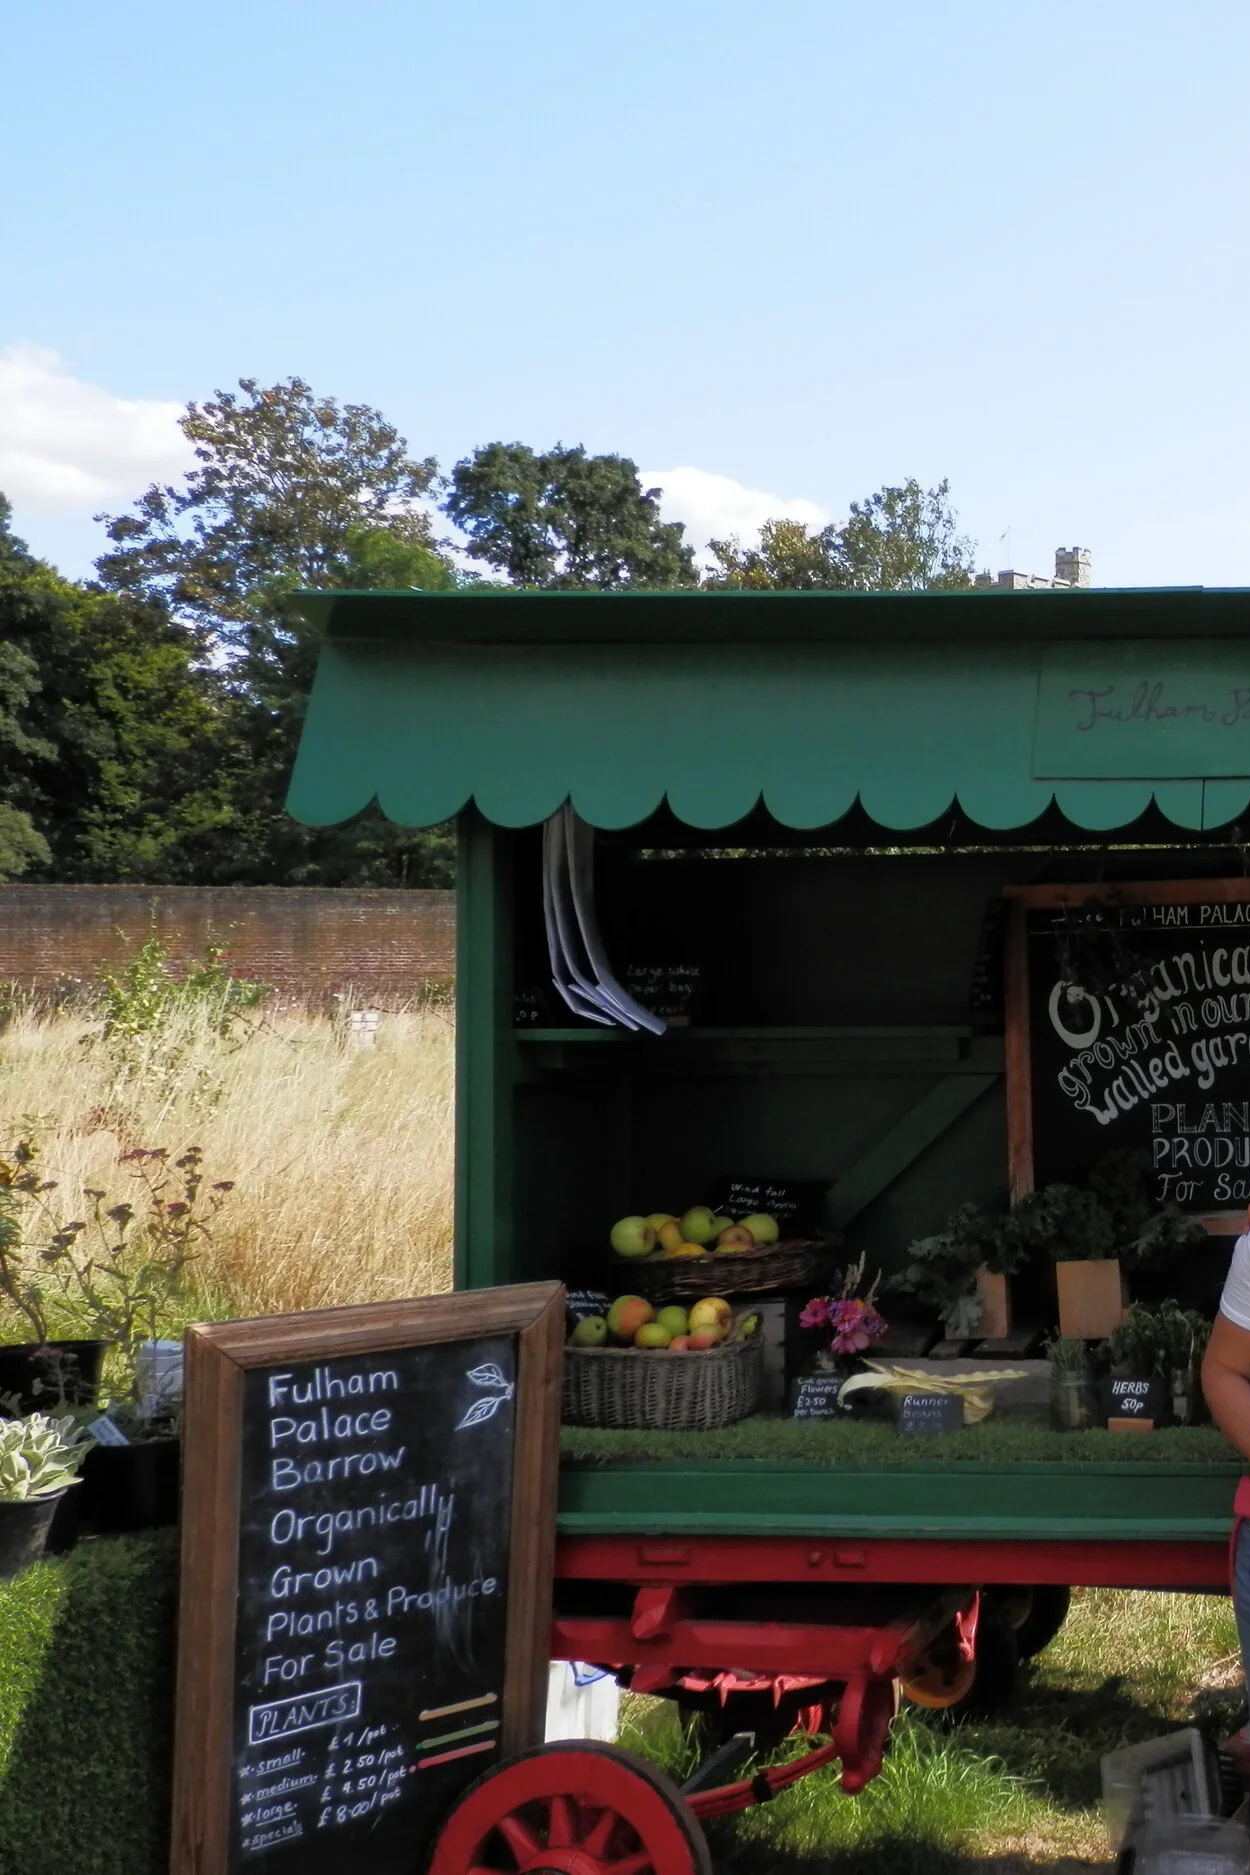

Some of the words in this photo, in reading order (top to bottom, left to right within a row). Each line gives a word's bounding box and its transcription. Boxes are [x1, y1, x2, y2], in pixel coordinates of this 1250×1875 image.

[1068, 681, 1217, 731] Fulham
[1057, 1018, 1162, 1110] grown
[1171, 1001, 1199, 1035] in
[1085, 1039, 1191, 1126] walled
[1155, 1171, 1204, 1202] For
[268, 1366, 398, 1408] Fulham
[800, 1384, 838, 1395] Flowers
[903, 1394, 949, 1408] Runner
[1112, 1380, 1150, 1395] HERBS
[1121, 1398, 1145, 1414] 50p
[270, 1406, 392, 1449] Palace
[272, 1445, 406, 1492] Barrow
[270, 1483, 456, 1556] Organically
[270, 1556, 378, 1599] Grown
[267, 1600, 359, 1643] Plants
[364, 1598, 379, 1621] &
[387, 1576, 497, 1617] Produce
[264, 1655, 315, 1686] For
[324, 1631, 397, 1667] Sale
